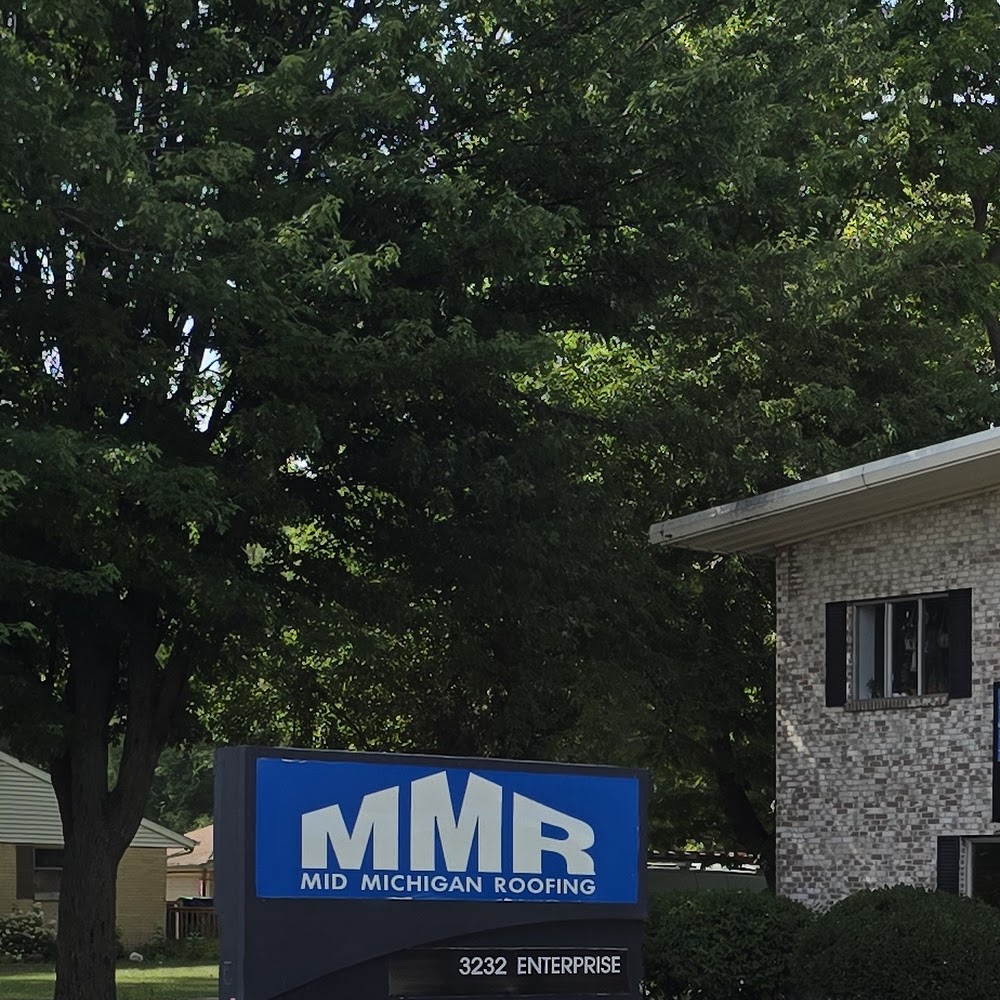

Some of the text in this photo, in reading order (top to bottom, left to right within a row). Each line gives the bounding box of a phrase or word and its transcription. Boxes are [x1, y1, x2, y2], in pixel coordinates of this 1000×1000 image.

[302, 771, 595, 875] MMR
[301, 873, 596, 895] MID MICHIGAN ROOFING
[458, 956, 621, 976] 3232 ENTERPRISE
